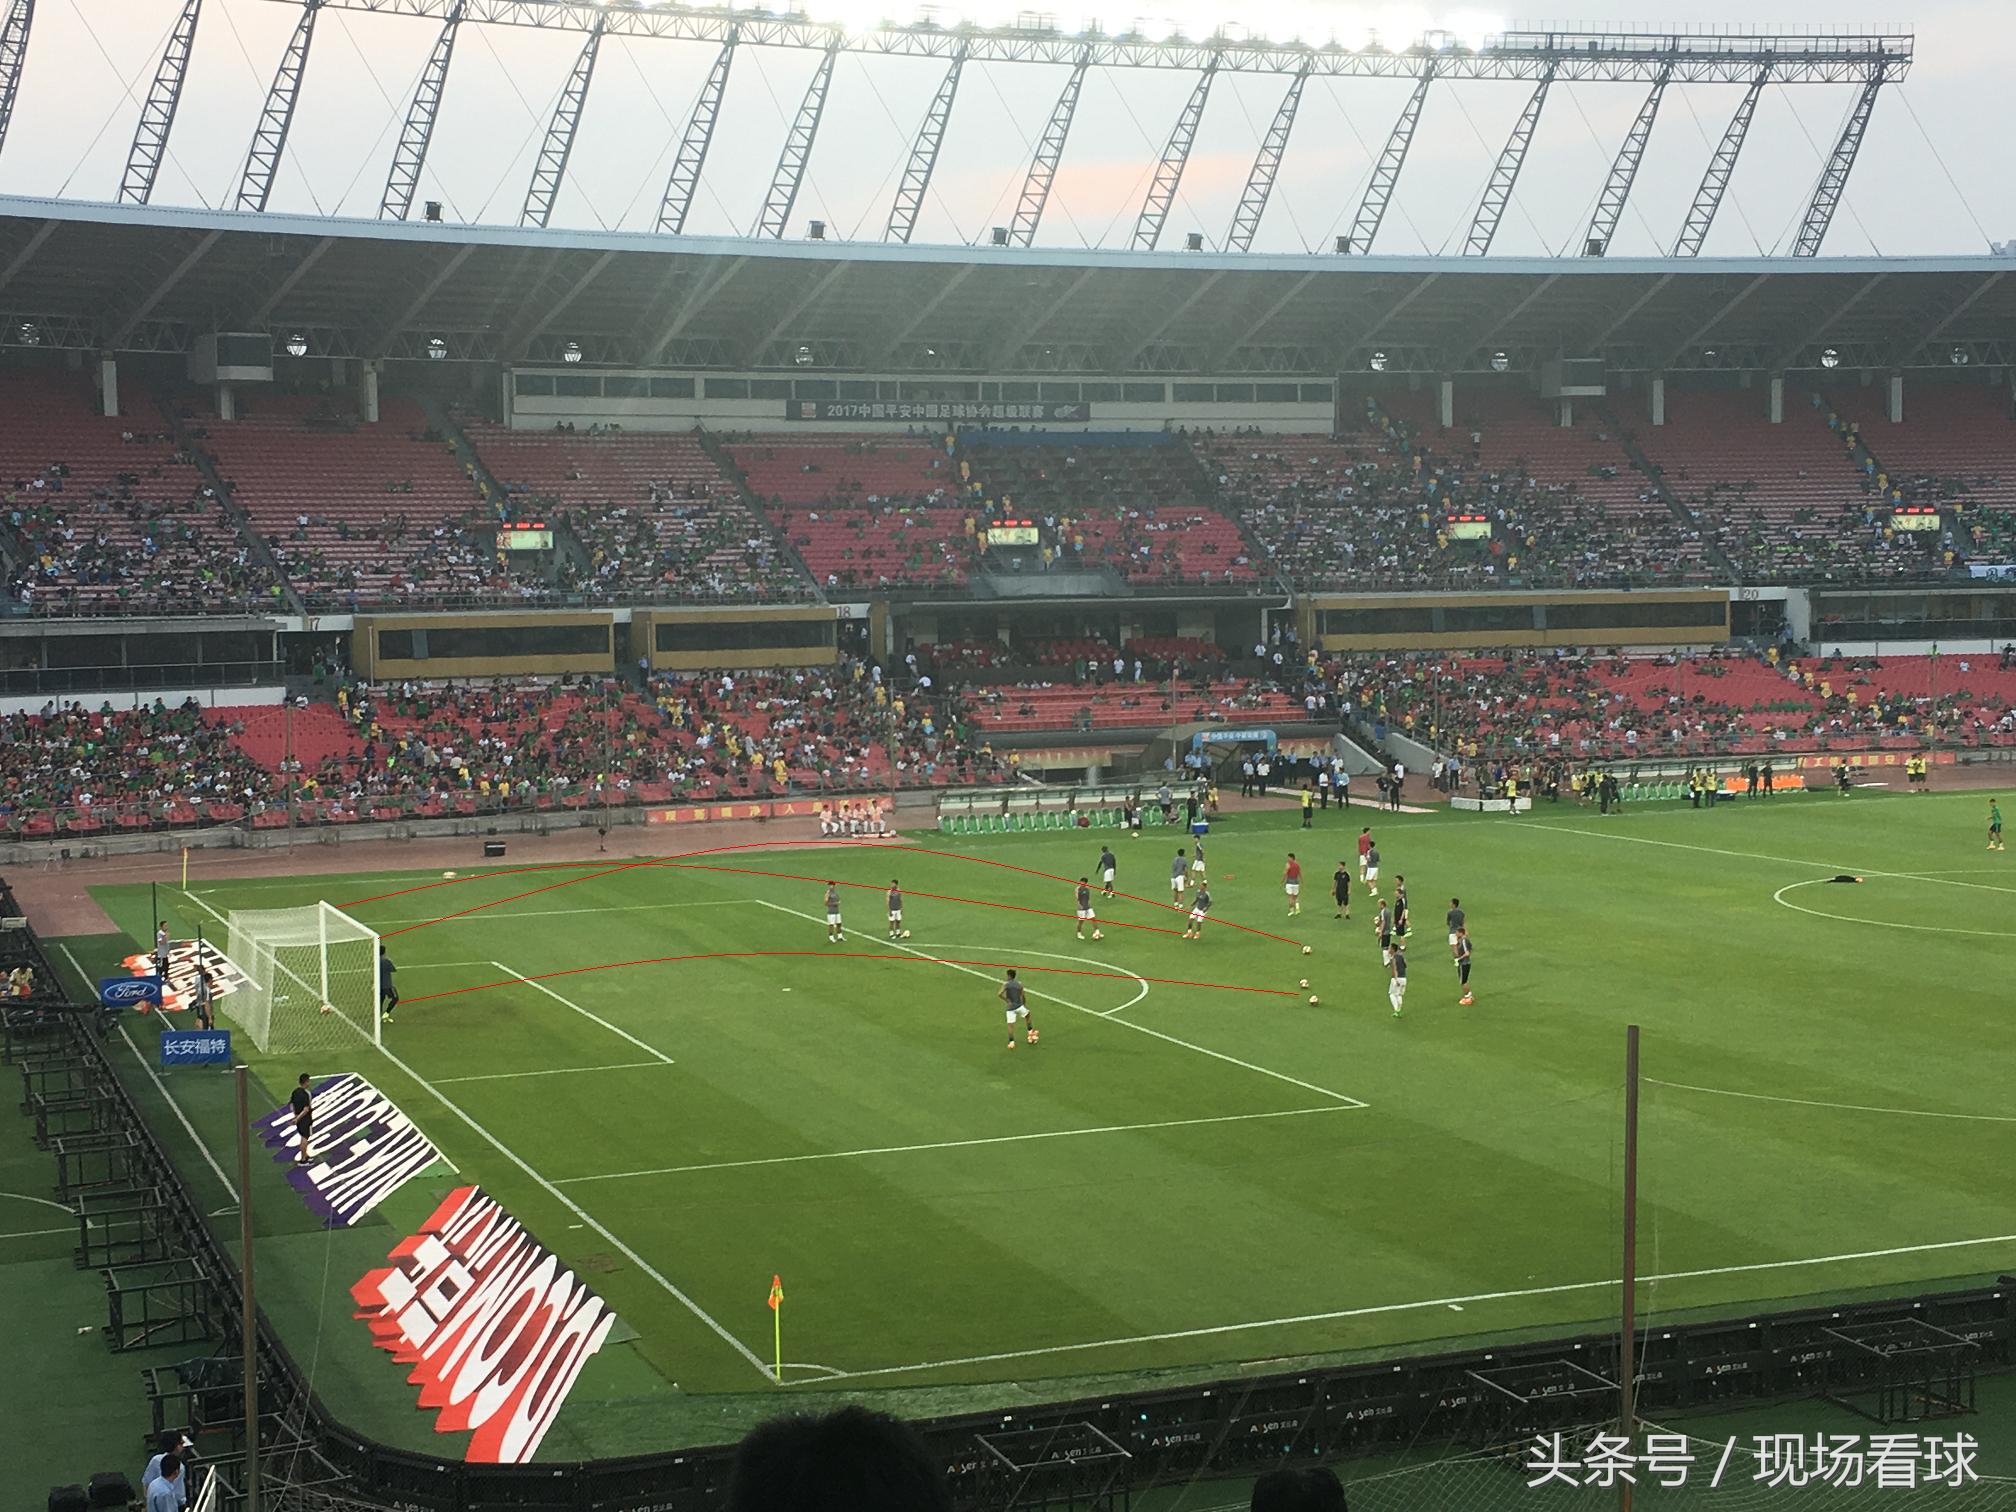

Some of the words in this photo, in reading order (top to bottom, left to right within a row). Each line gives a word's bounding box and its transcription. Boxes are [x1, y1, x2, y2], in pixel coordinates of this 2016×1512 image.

[1743, 589, 1759, 600] 20
[838, 606, 851, 618] 18
[114, 984, 148, 998] Ford
[163, 1037, 226, 1055] 长安福特
